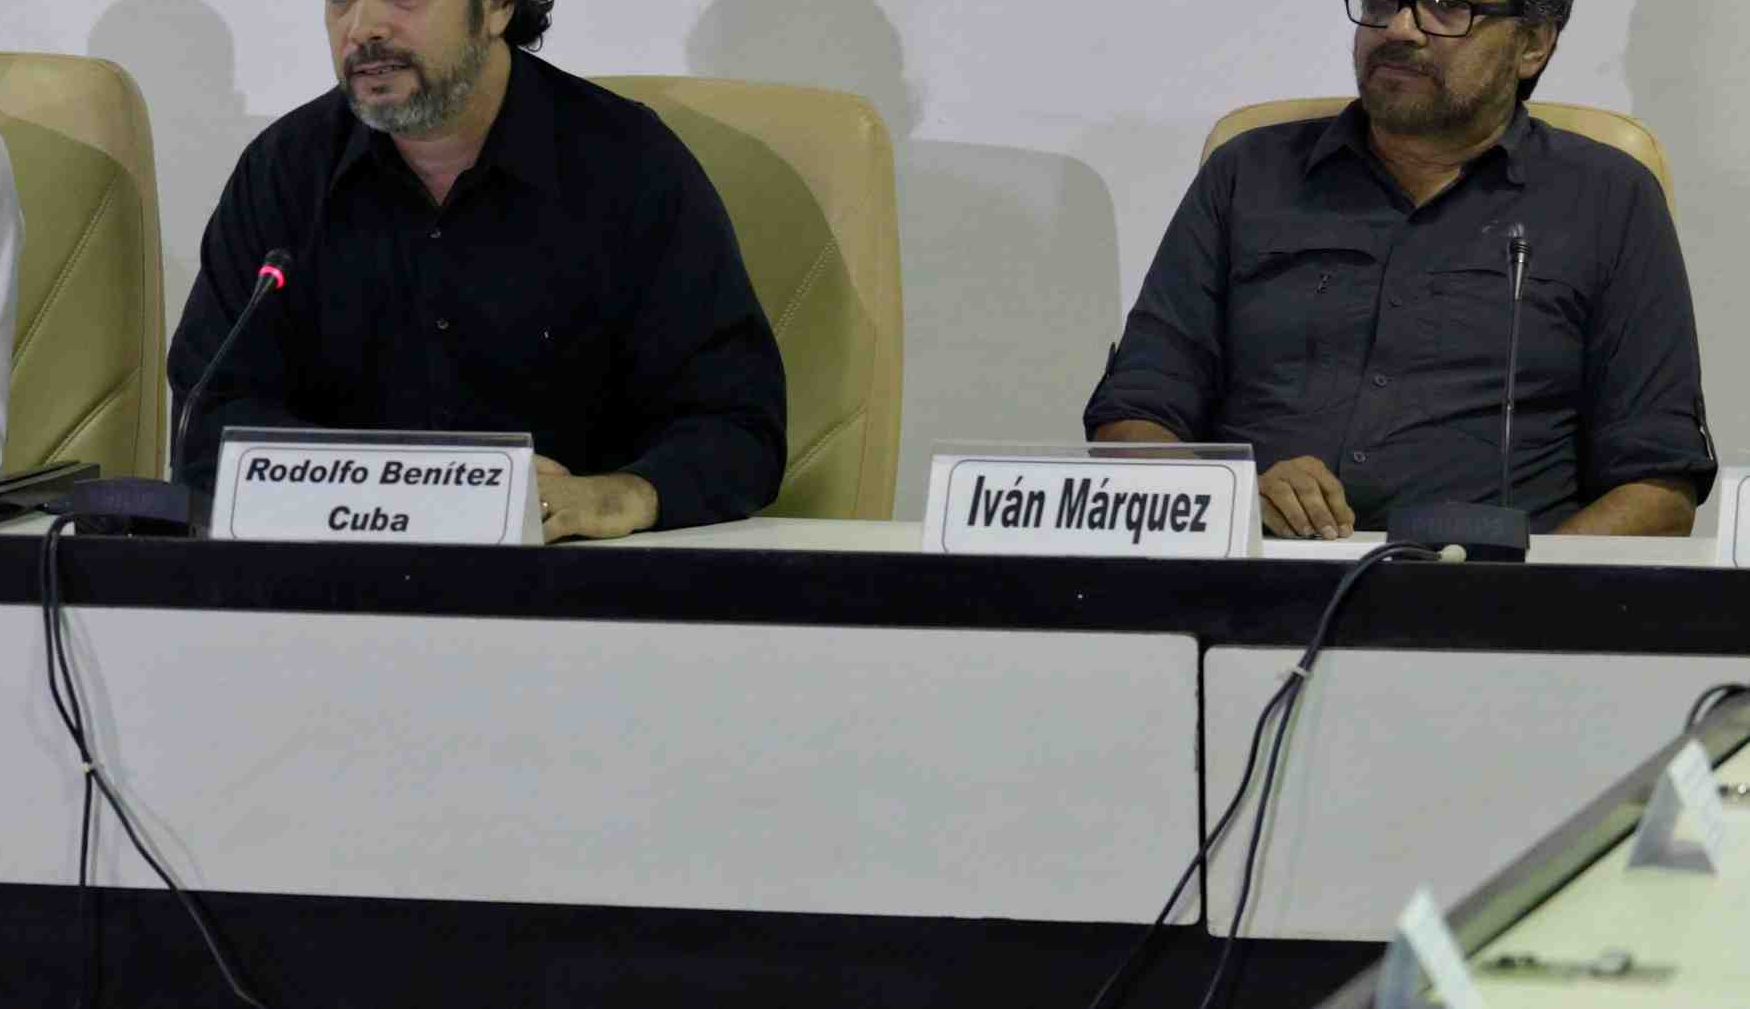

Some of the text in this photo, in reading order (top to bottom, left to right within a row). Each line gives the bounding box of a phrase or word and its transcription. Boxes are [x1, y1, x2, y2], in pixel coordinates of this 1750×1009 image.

[245, 457, 503, 487] Rodolfo Benítez
[327, 504, 410, 533] Cuba
[966, 474, 1212, 545] Iván Márquez
